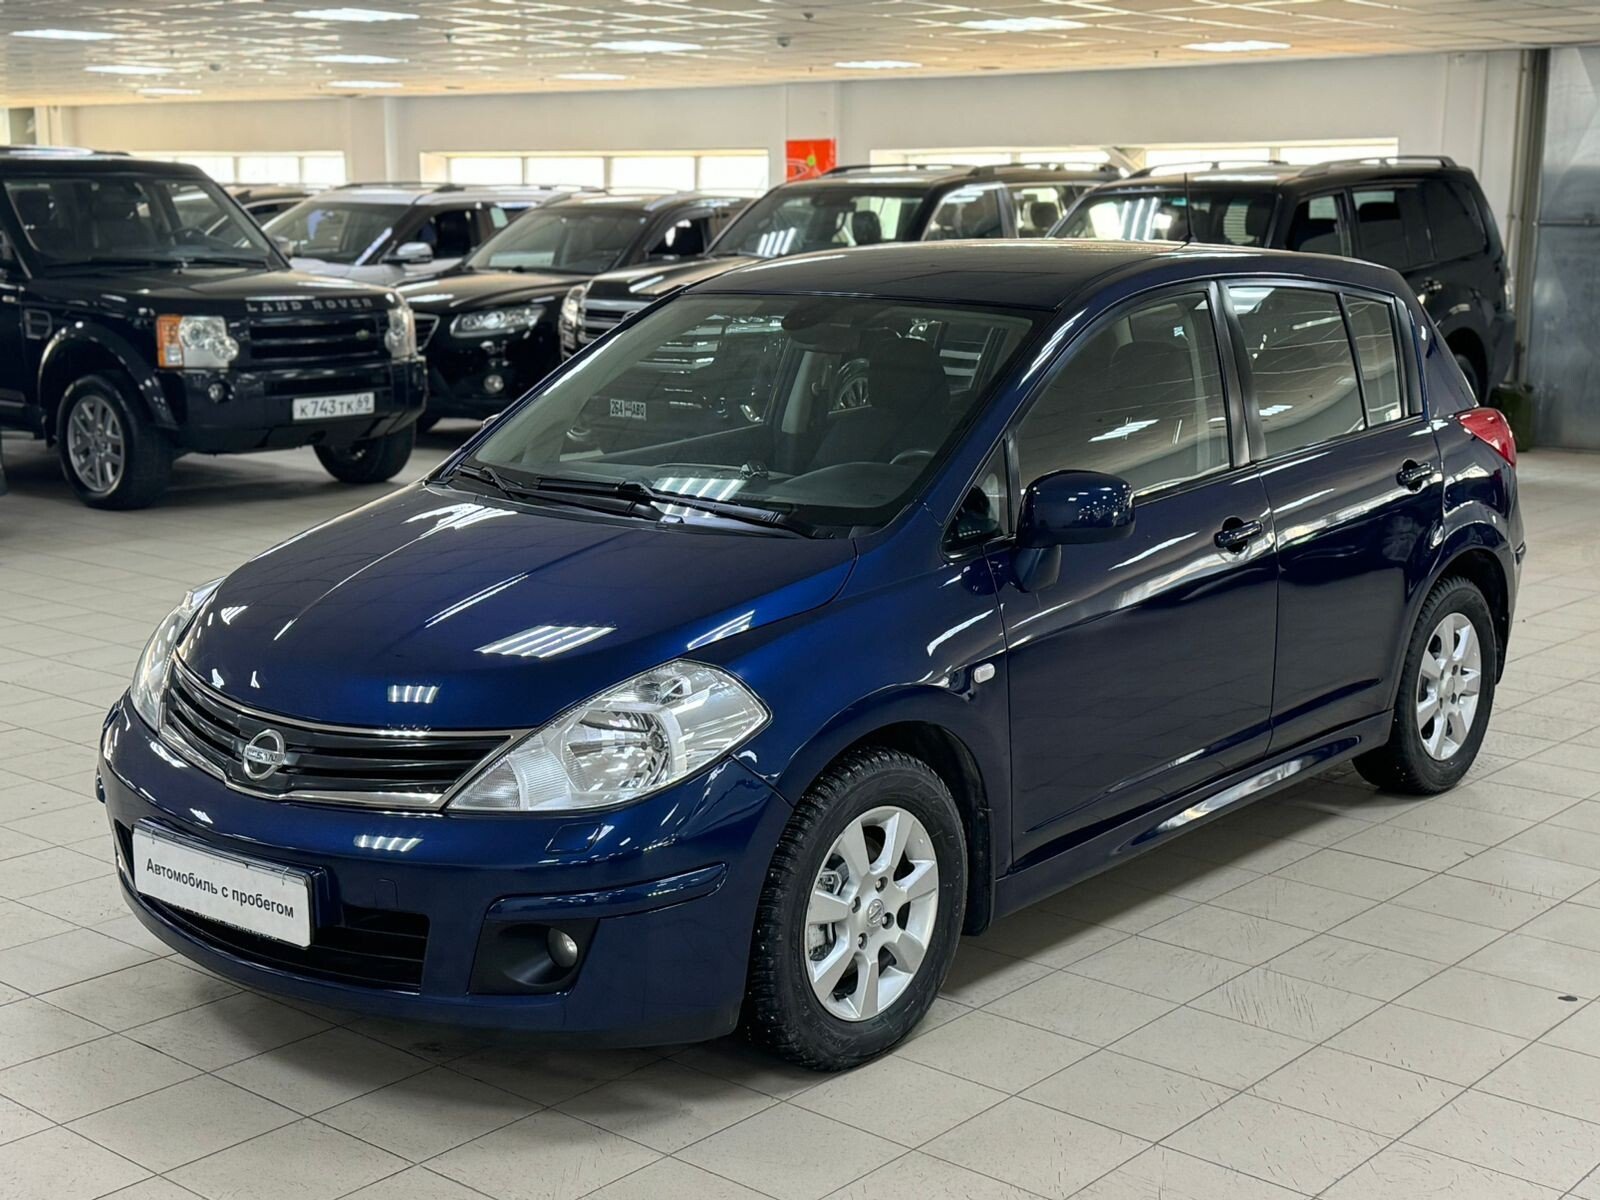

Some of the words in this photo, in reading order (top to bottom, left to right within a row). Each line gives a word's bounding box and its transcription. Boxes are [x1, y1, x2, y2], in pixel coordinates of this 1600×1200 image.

[246, 302, 303, 313] LAND
[311, 298, 373, 311] ROVER
[246, 746, 282, 763] SSAN
[146, 857, 218, 896] Автомобиль
[221, 886, 229, 898] с
[231, 888, 294, 919] пробегом
